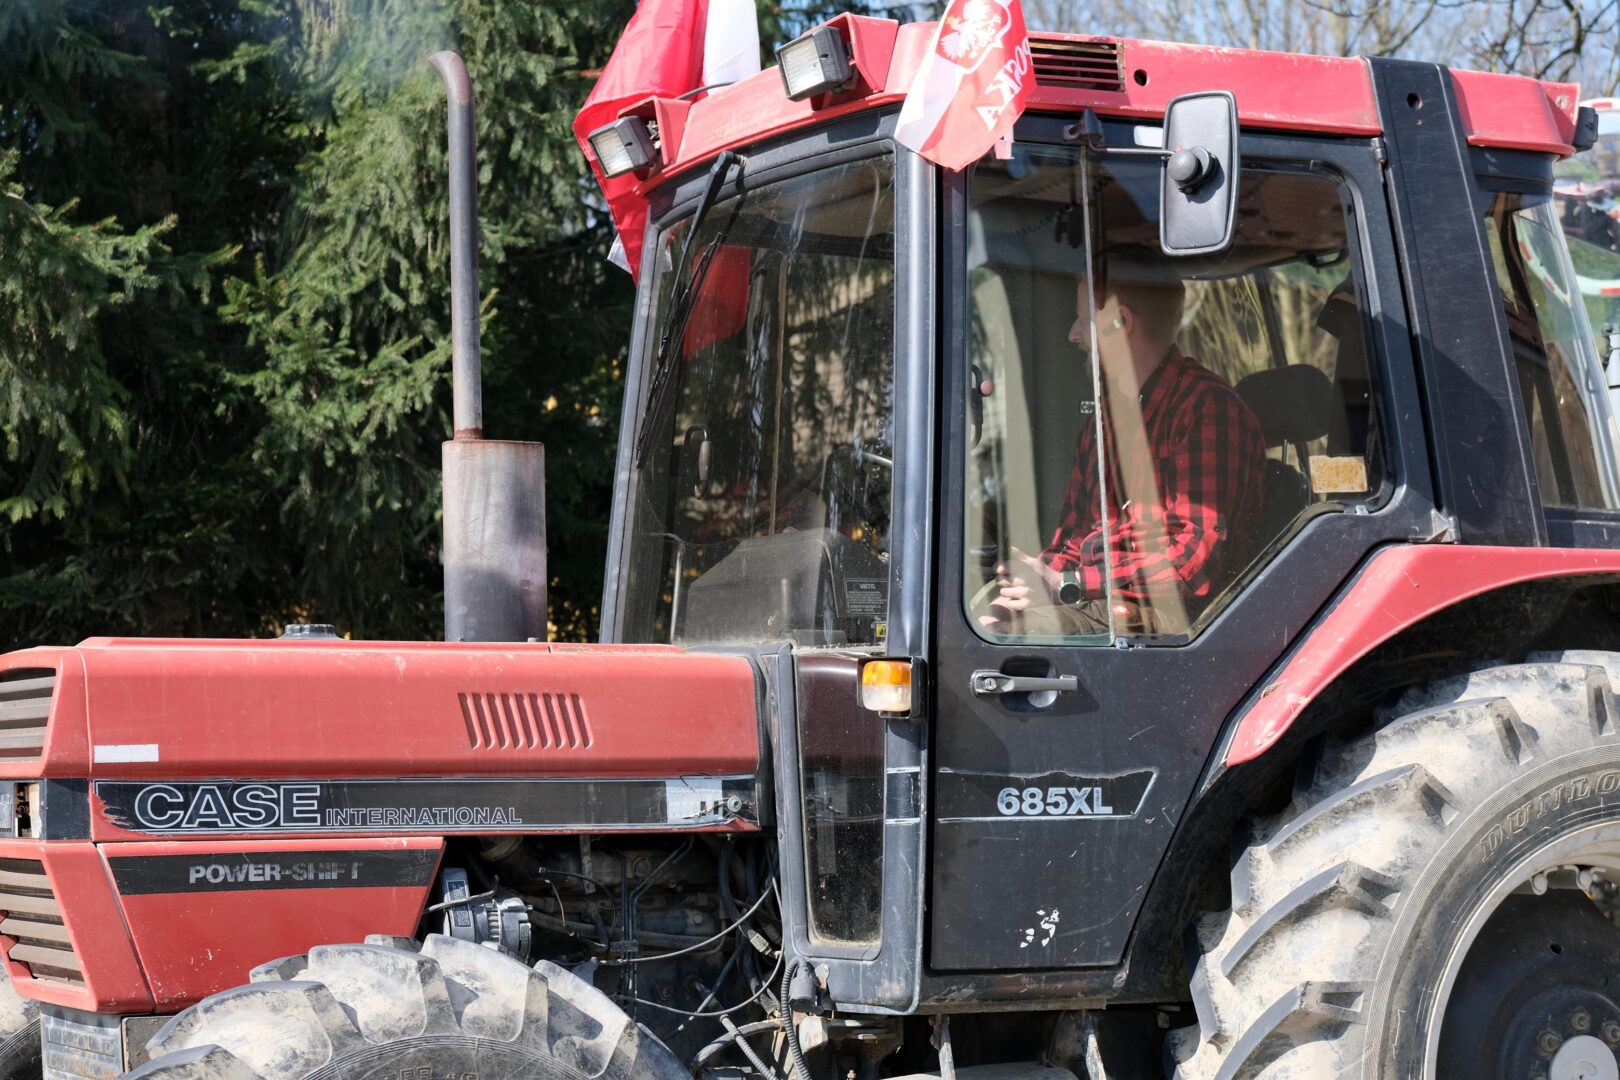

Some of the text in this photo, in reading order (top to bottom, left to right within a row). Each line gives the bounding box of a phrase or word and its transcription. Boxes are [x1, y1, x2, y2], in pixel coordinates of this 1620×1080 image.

[134, 784, 523, 828] CASE INTERNATIONAL
[997, 787, 1113, 816] 685XL
